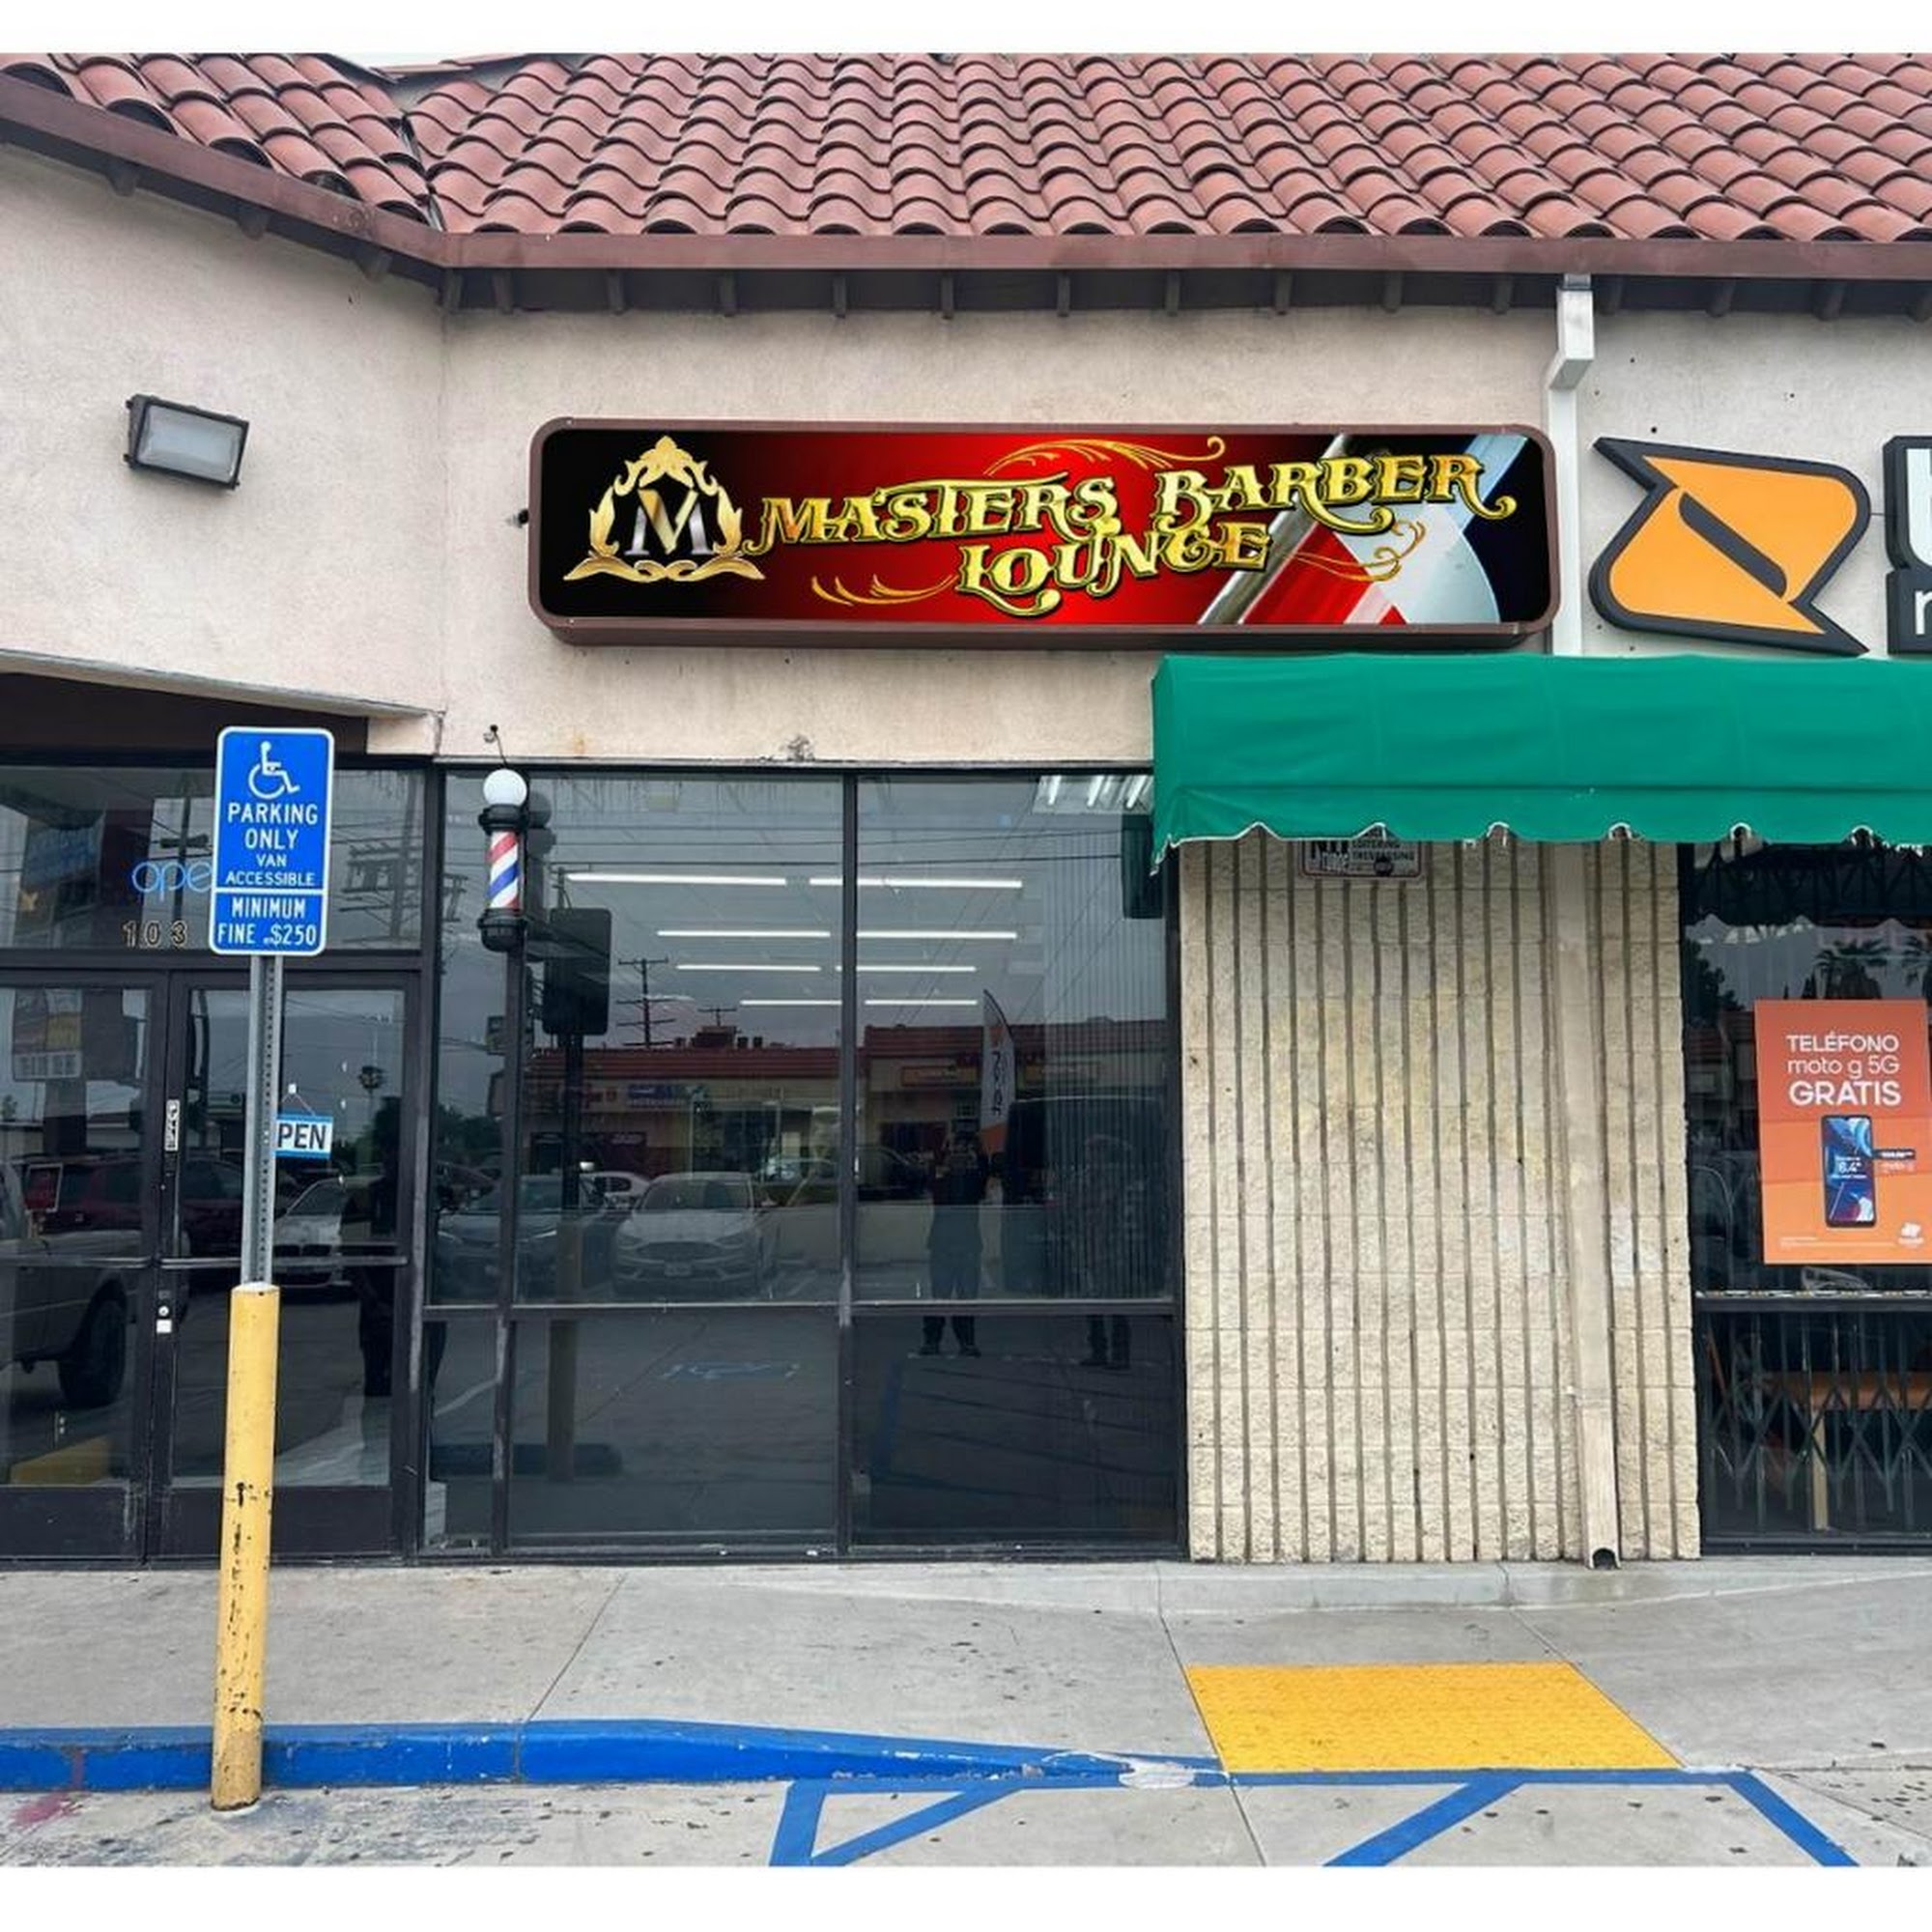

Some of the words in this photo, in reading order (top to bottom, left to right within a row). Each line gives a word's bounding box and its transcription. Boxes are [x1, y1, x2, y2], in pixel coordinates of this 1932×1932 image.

[742, 471, 1122, 555] MASTERS
[1153, 452, 1517, 534] BARBER
[954, 518, 1272, 618] LOUNGE
[227, 802, 318, 825] PARKING
[244, 828, 298, 850] ONLY
[255, 854, 288, 867] VAN
[131, 861, 213, 902] ope
[225, 871, 316, 886] ACCESSIBLE
[232, 896, 306, 919] MINIMUM
[122, 920, 187, 947] 103
[217, 923, 257, 945] FINE
[1786, 1030, 1899, 1053] TELÉFONO
[1787, 1057, 1843, 1074] moto
[1847, 1059, 1863, 1080] g
[1868, 1054, 1900, 1075] 5G
[1788, 1080, 1902, 1107] GRATIS
[277, 1122, 327, 1151] PEN
